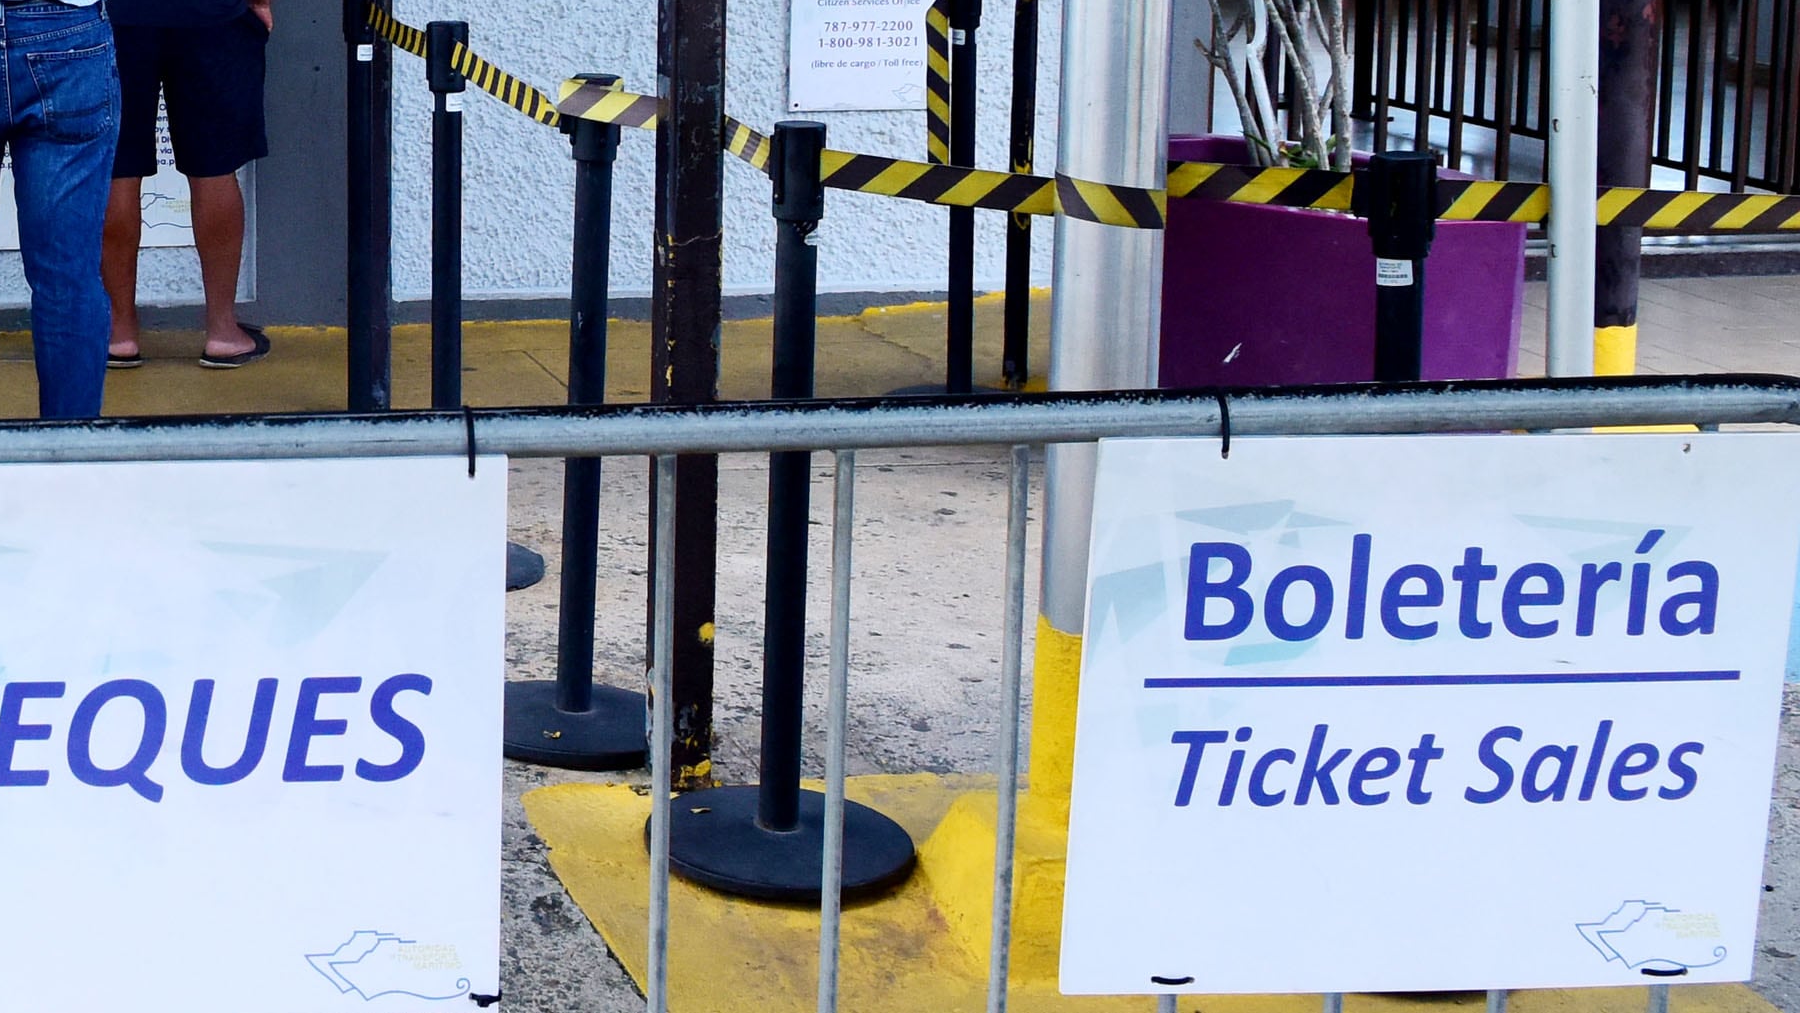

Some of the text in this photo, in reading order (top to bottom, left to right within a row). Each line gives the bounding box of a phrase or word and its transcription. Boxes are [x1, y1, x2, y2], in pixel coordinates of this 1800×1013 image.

[824, 20, 914, 32] 787-977-2200
[818, 37, 919, 48] 1-800-981-3021
[811, 59, 835, 69] (libre
[837, 60, 848, 68] de
[850, 60, 876, 70] cargo
[884, 59, 899, 67] Toll
[902, 58, 924, 69] free)
[1183, 528, 1721, 642] Boletería
[1170, 719, 1705, 807] Ticket Sales
